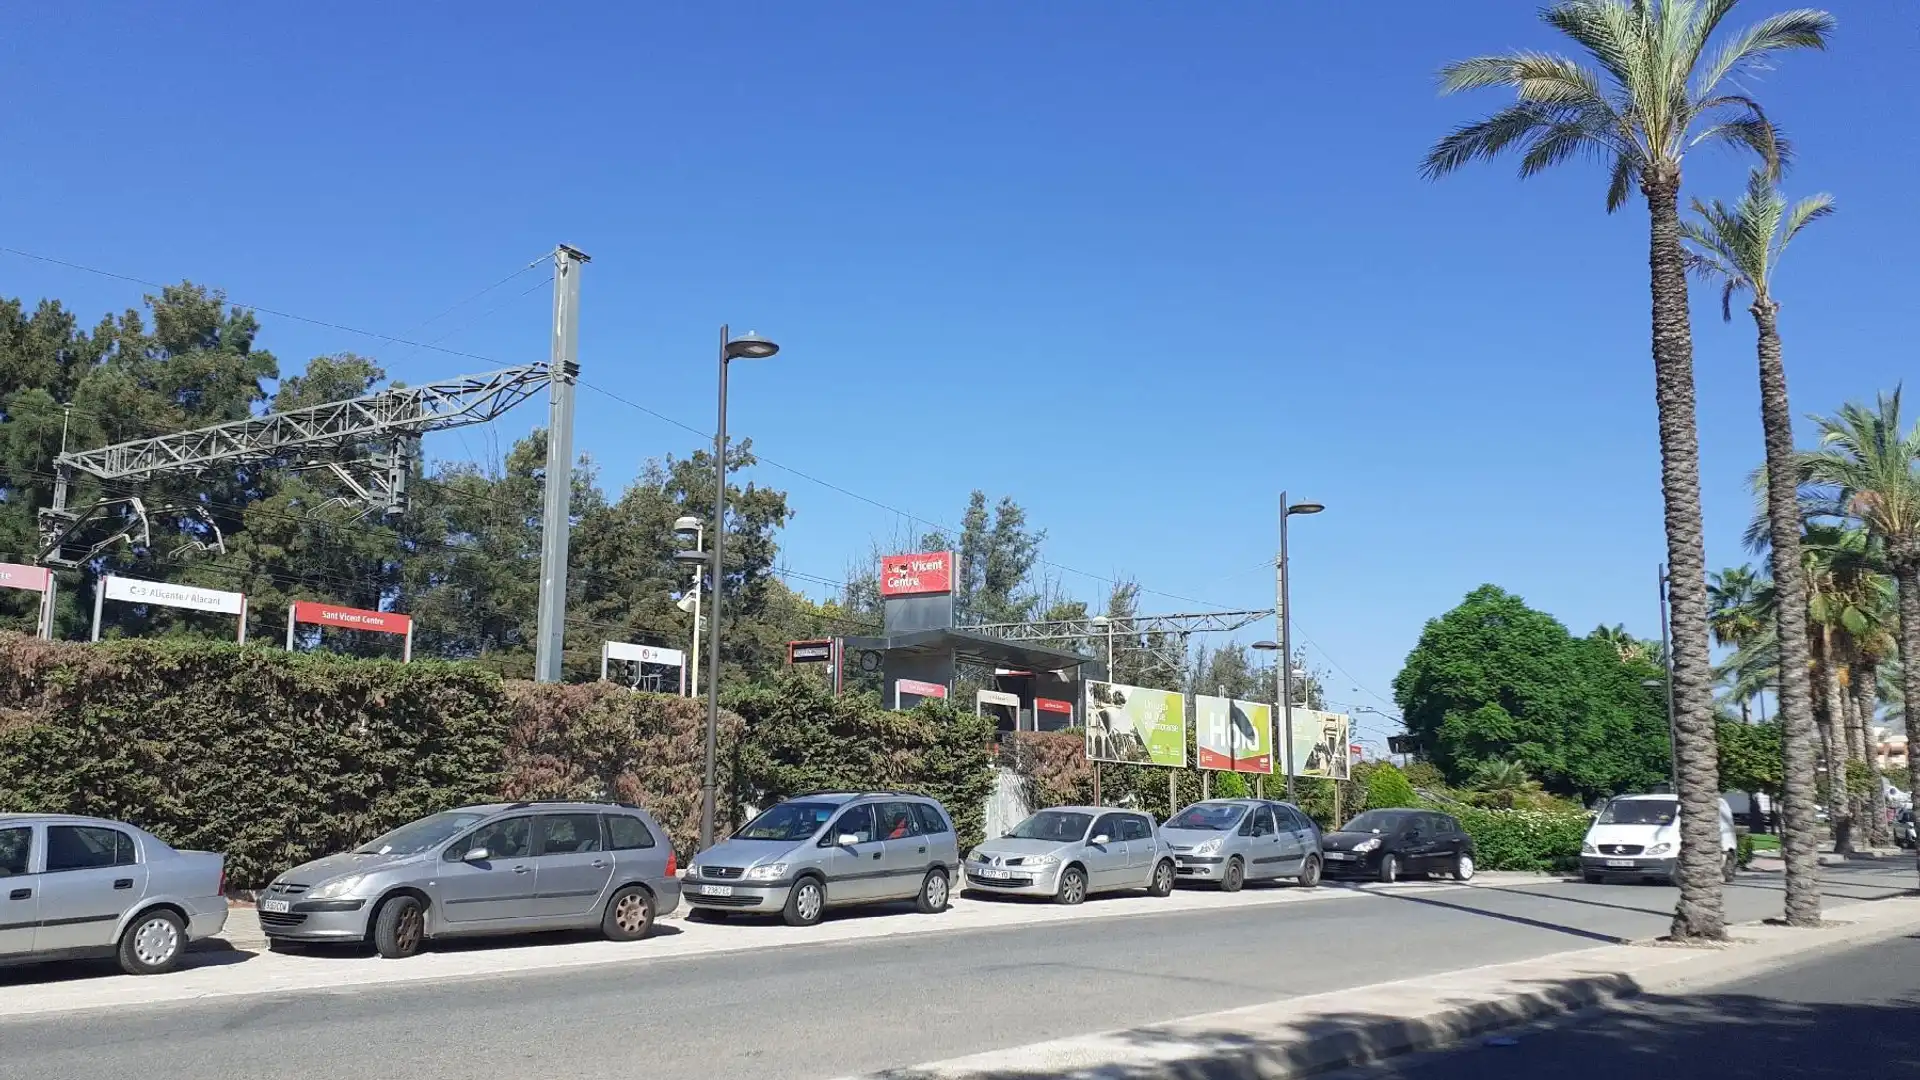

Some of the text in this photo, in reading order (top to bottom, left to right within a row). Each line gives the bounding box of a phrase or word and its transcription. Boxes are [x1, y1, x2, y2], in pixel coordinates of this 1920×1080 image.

[911, 559, 943, 573] Vicent
[887, 575, 920, 588] Centre
[149, 588, 184, 601] Alicante
[191, 594, 220, 606] Alacant
[321, 610, 384, 626] Sant Vicent Centre
